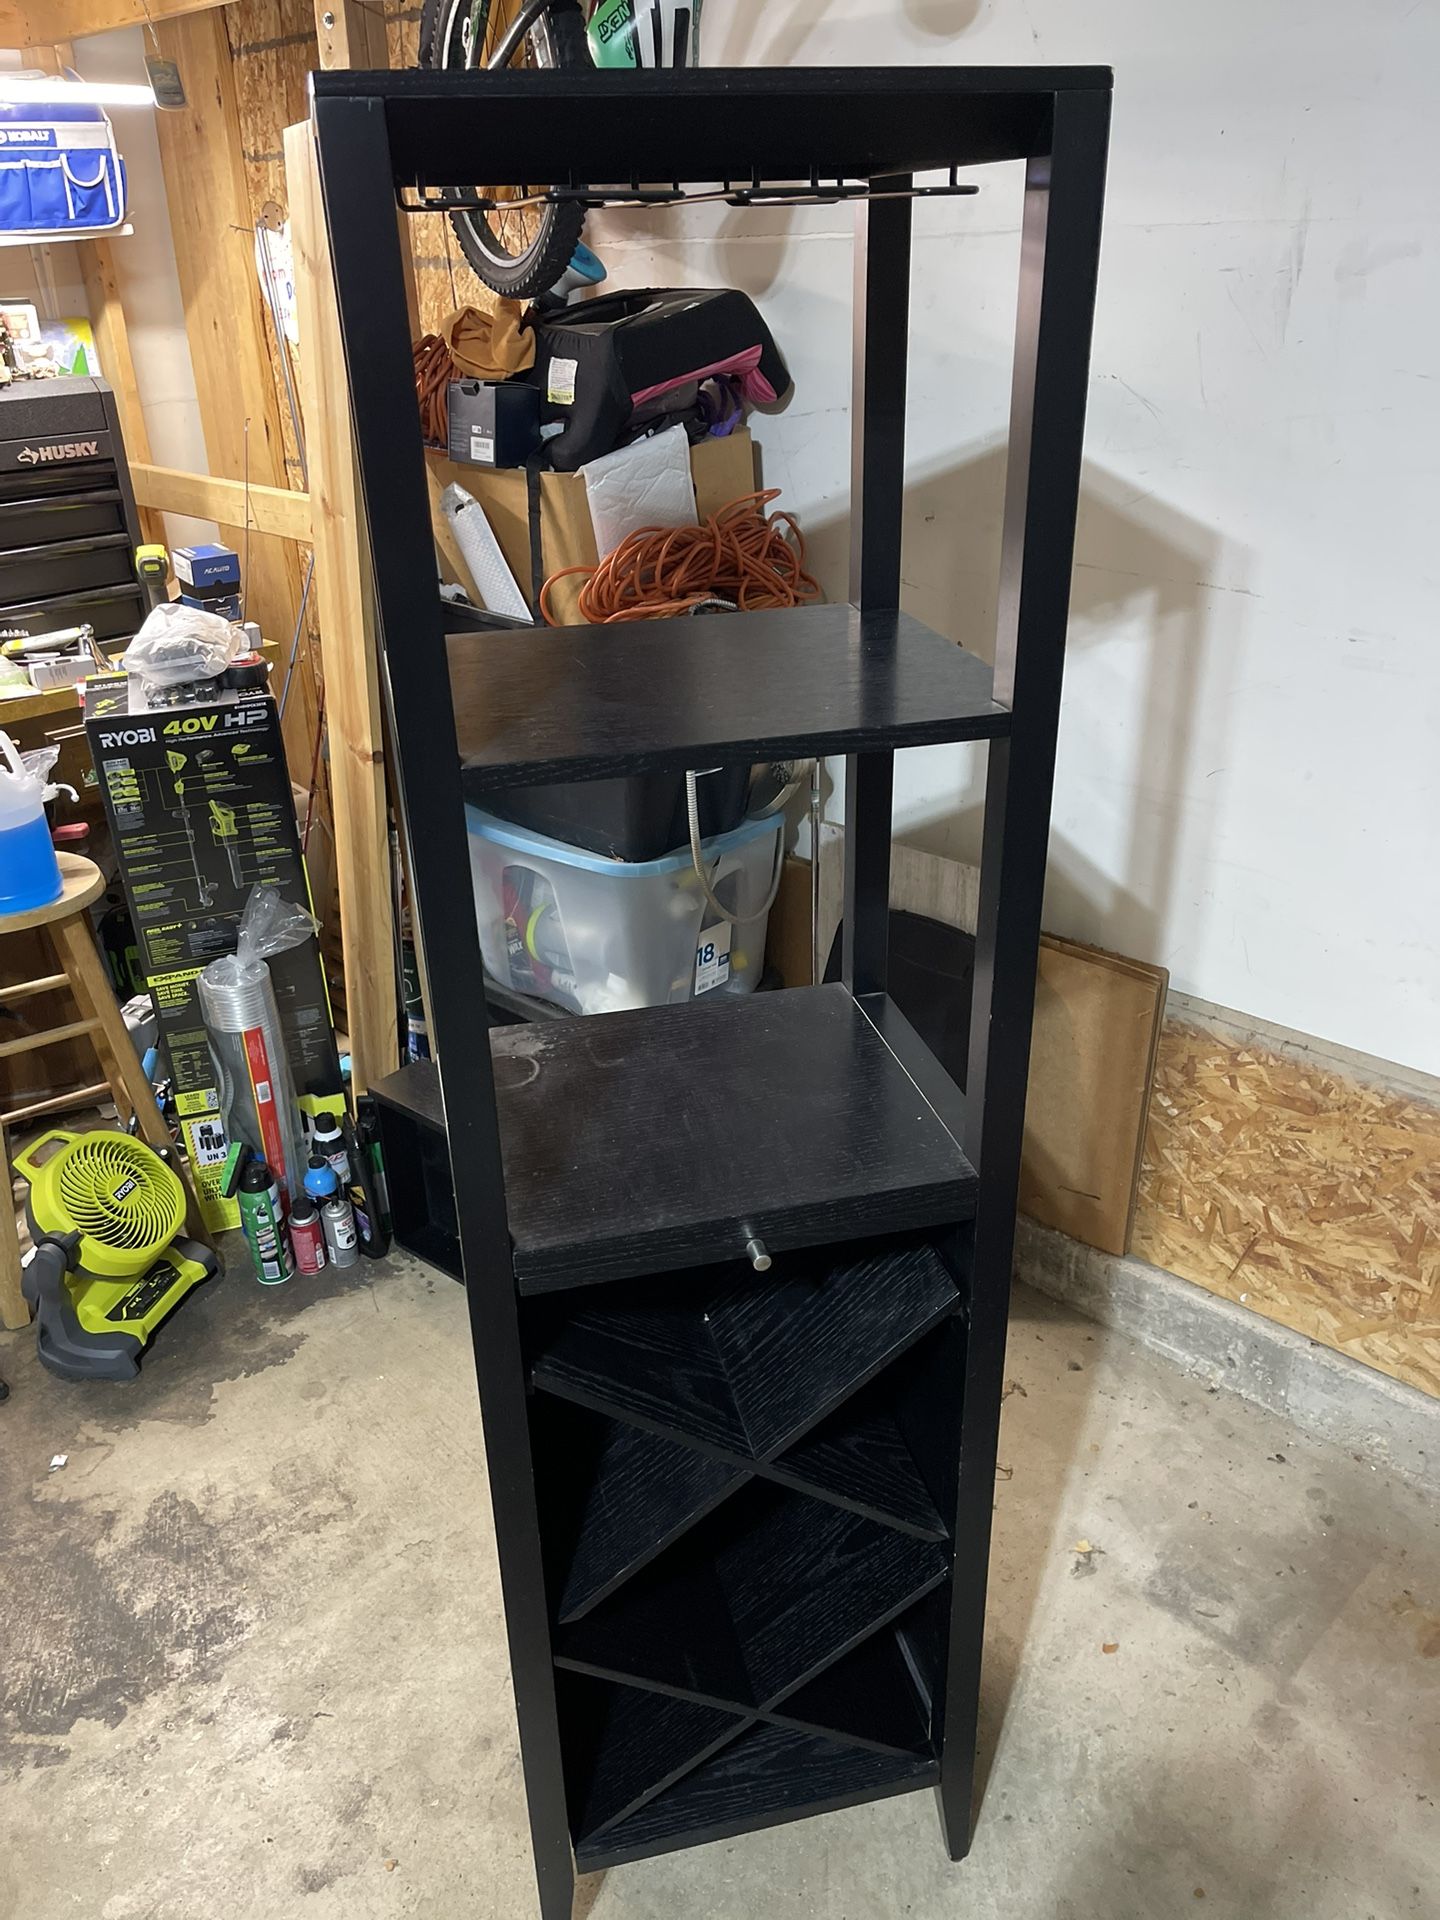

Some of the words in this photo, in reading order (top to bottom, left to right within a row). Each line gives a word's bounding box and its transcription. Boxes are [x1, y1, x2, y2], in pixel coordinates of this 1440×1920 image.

[597, 2, 631, 44] NEXT
[6, 130, 50, 142] KOBALT
[38, 441, 99, 461] HUSKY
[163, 715, 218, 735] 40V
[224, 709, 268, 727] HP
[98, 727, 157, 748] RYOBI
[696, 942, 715, 967] 18
[206, 1152, 219, 1161] UN
[114, 1180, 136, 1200] RYOBI
